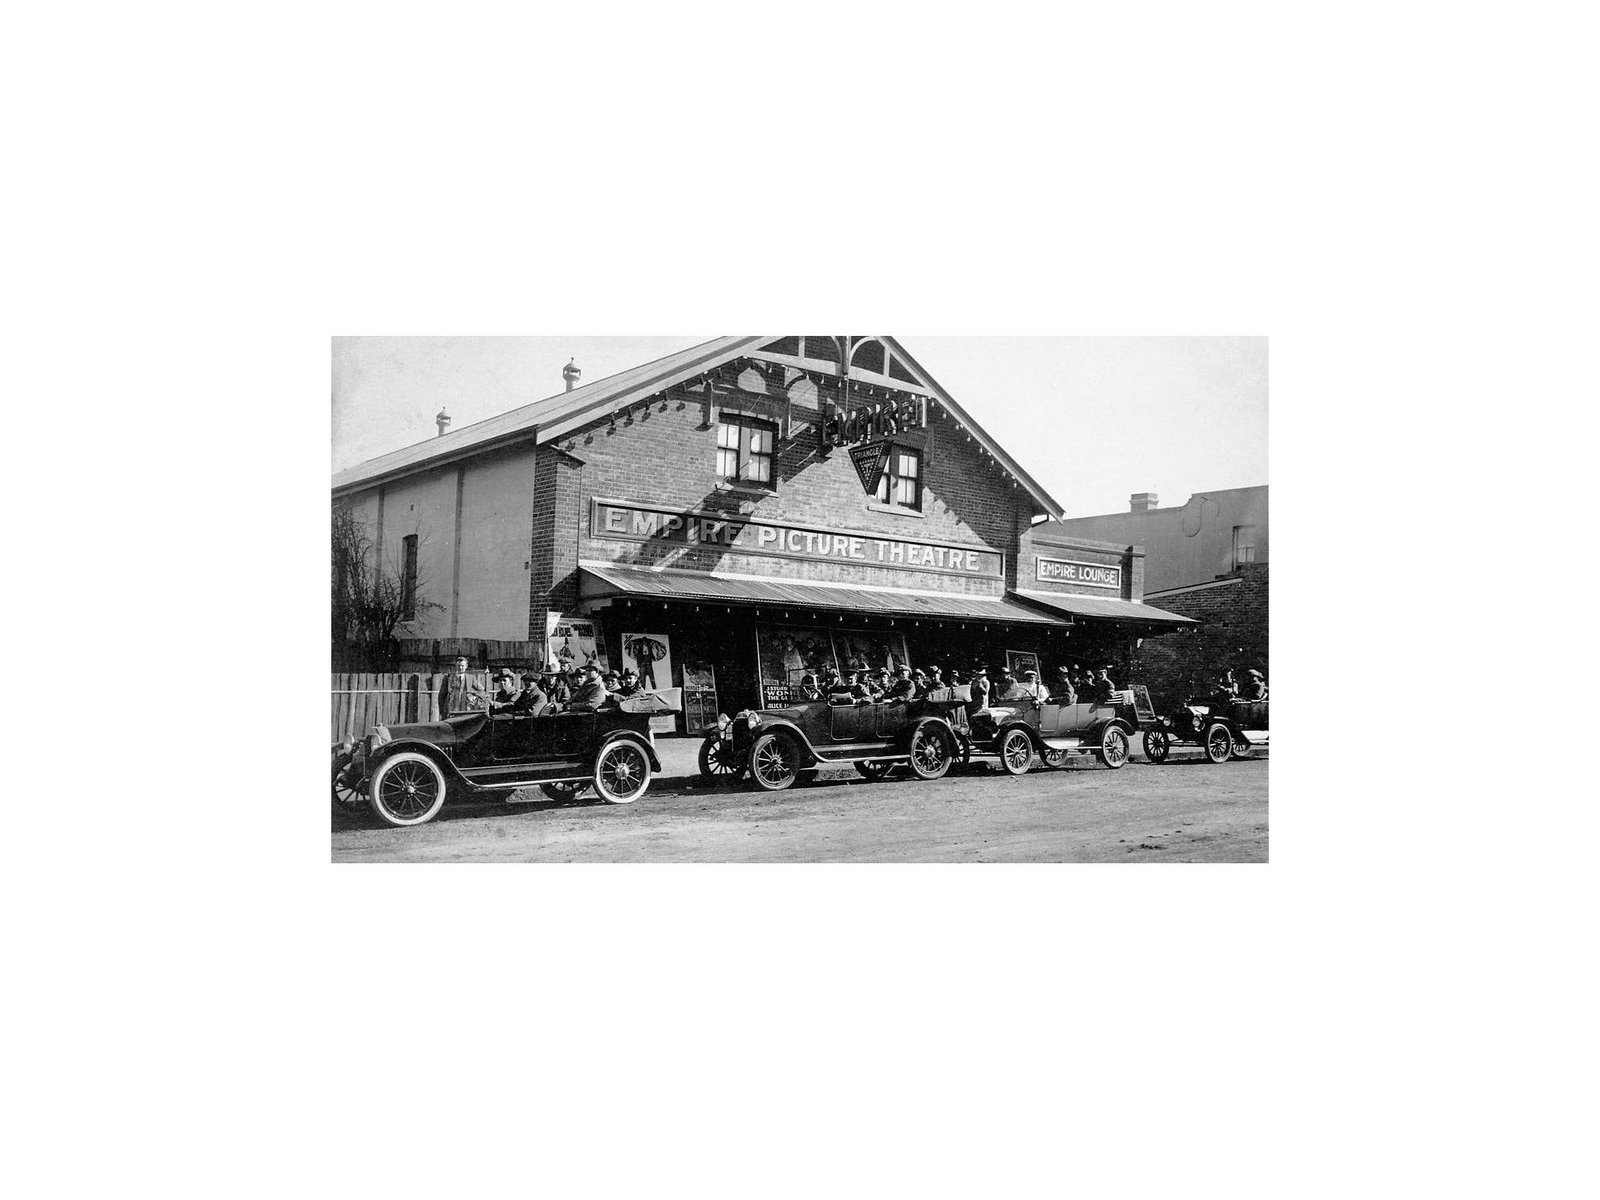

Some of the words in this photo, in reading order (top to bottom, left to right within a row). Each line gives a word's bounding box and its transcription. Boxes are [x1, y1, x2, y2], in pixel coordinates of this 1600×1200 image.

[854, 447, 879, 459] TRIANGLE
[605, 507, 743, 546] EMPIRE
[757, 526, 866, 559] PICTURE
[875, 540, 980, 571] THEATRE
[1040, 562, 1076, 578] EMPIRE
[1079, 567, 1116, 584] LOUNGE
